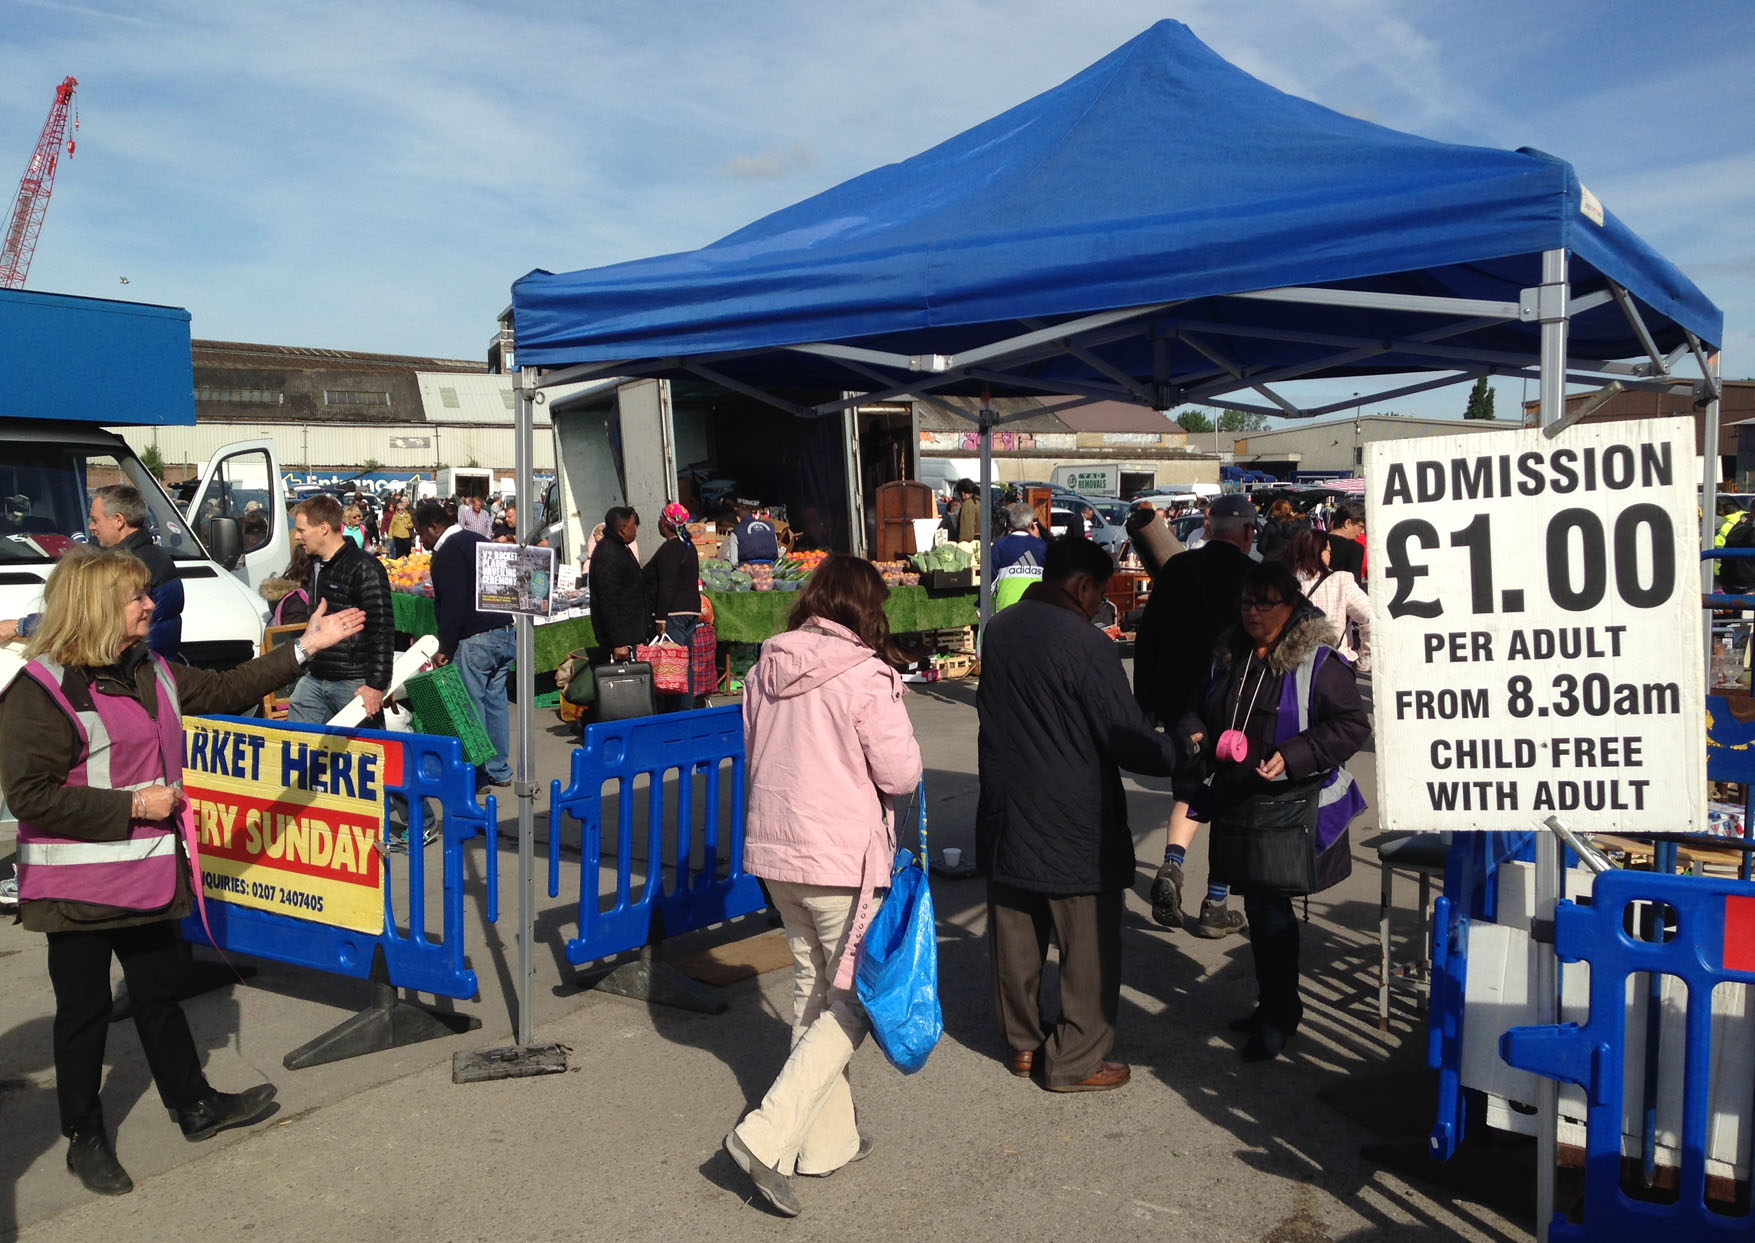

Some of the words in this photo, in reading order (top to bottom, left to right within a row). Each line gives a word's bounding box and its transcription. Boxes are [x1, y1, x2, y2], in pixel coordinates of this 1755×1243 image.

[1078, 479, 1107, 489] REMOVALS
[1382, 441, 1673, 506] ADMISSION
[482, 550, 493, 560] V2
[494, 551, 518, 561] ROCKET
[482, 567, 517, 578] UNVEILING
[1008, 565, 1042, 575] adidas
[1385, 502, 1677, 620] £1.00
[482, 576, 518, 586] CEREMONY
[1424, 631, 1494, 664] PER
[1507, 625, 1627, 661] ADULT
[1396, 688, 1490, 720] FROM
[1507, 672, 1681, 718] 8.30am
[181, 726, 265, 781] RKET
[281, 740, 378, 801] HERE
[1430, 738, 1537, 770] CHILD
[1551, 736, 1643, 768] FREE
[1426, 781, 1519, 811] WITH
[1532, 780, 1650, 811] ADULT
[246, 808, 375, 875] SUNDAY
[202, 871, 249, 895] QUIRIES:
[252, 881, 276, 901] 0207
[279, 888, 324, 912] 2407405
